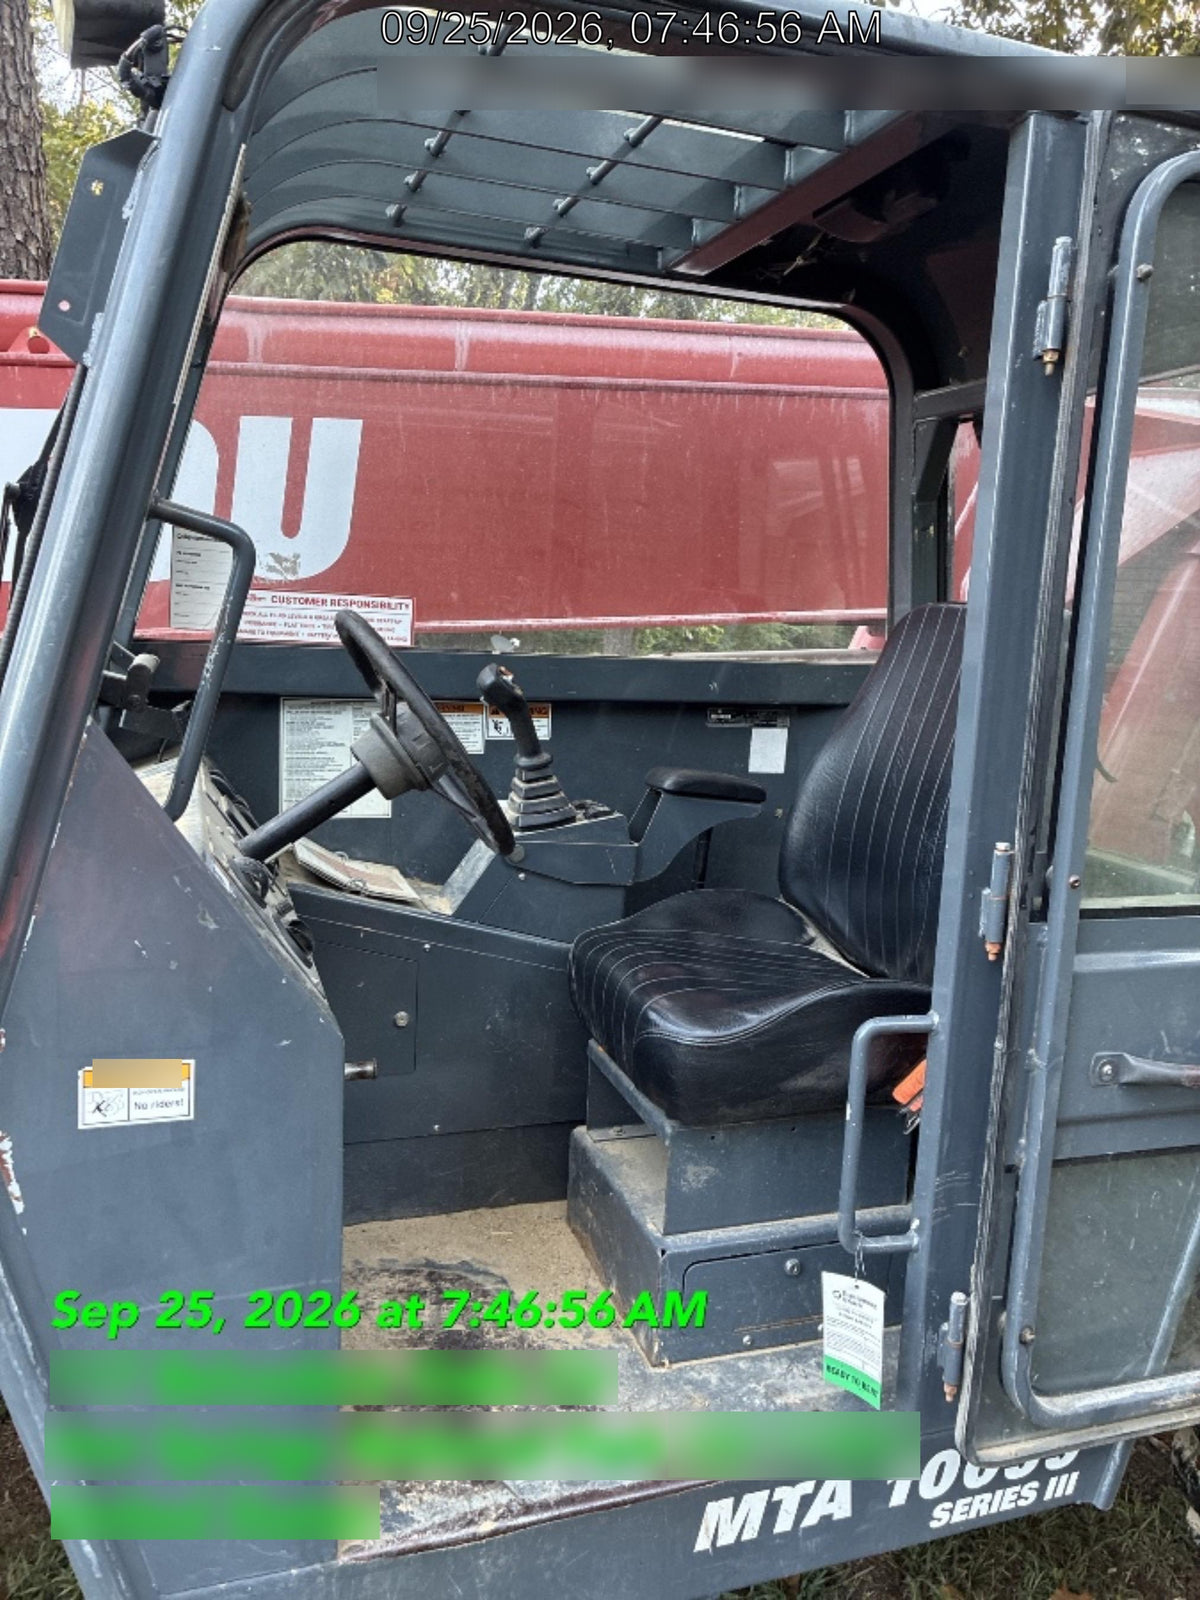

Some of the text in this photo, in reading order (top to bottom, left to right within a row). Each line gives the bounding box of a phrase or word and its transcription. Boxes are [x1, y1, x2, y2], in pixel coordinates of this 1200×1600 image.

[271, 595, 327, 607] CUSTOMER
[330, 599, 409, 610] RESPONSIBILITY
[693, 1480, 852, 1553] MTA
[929, 1471, 1080, 1529] SERIES III
